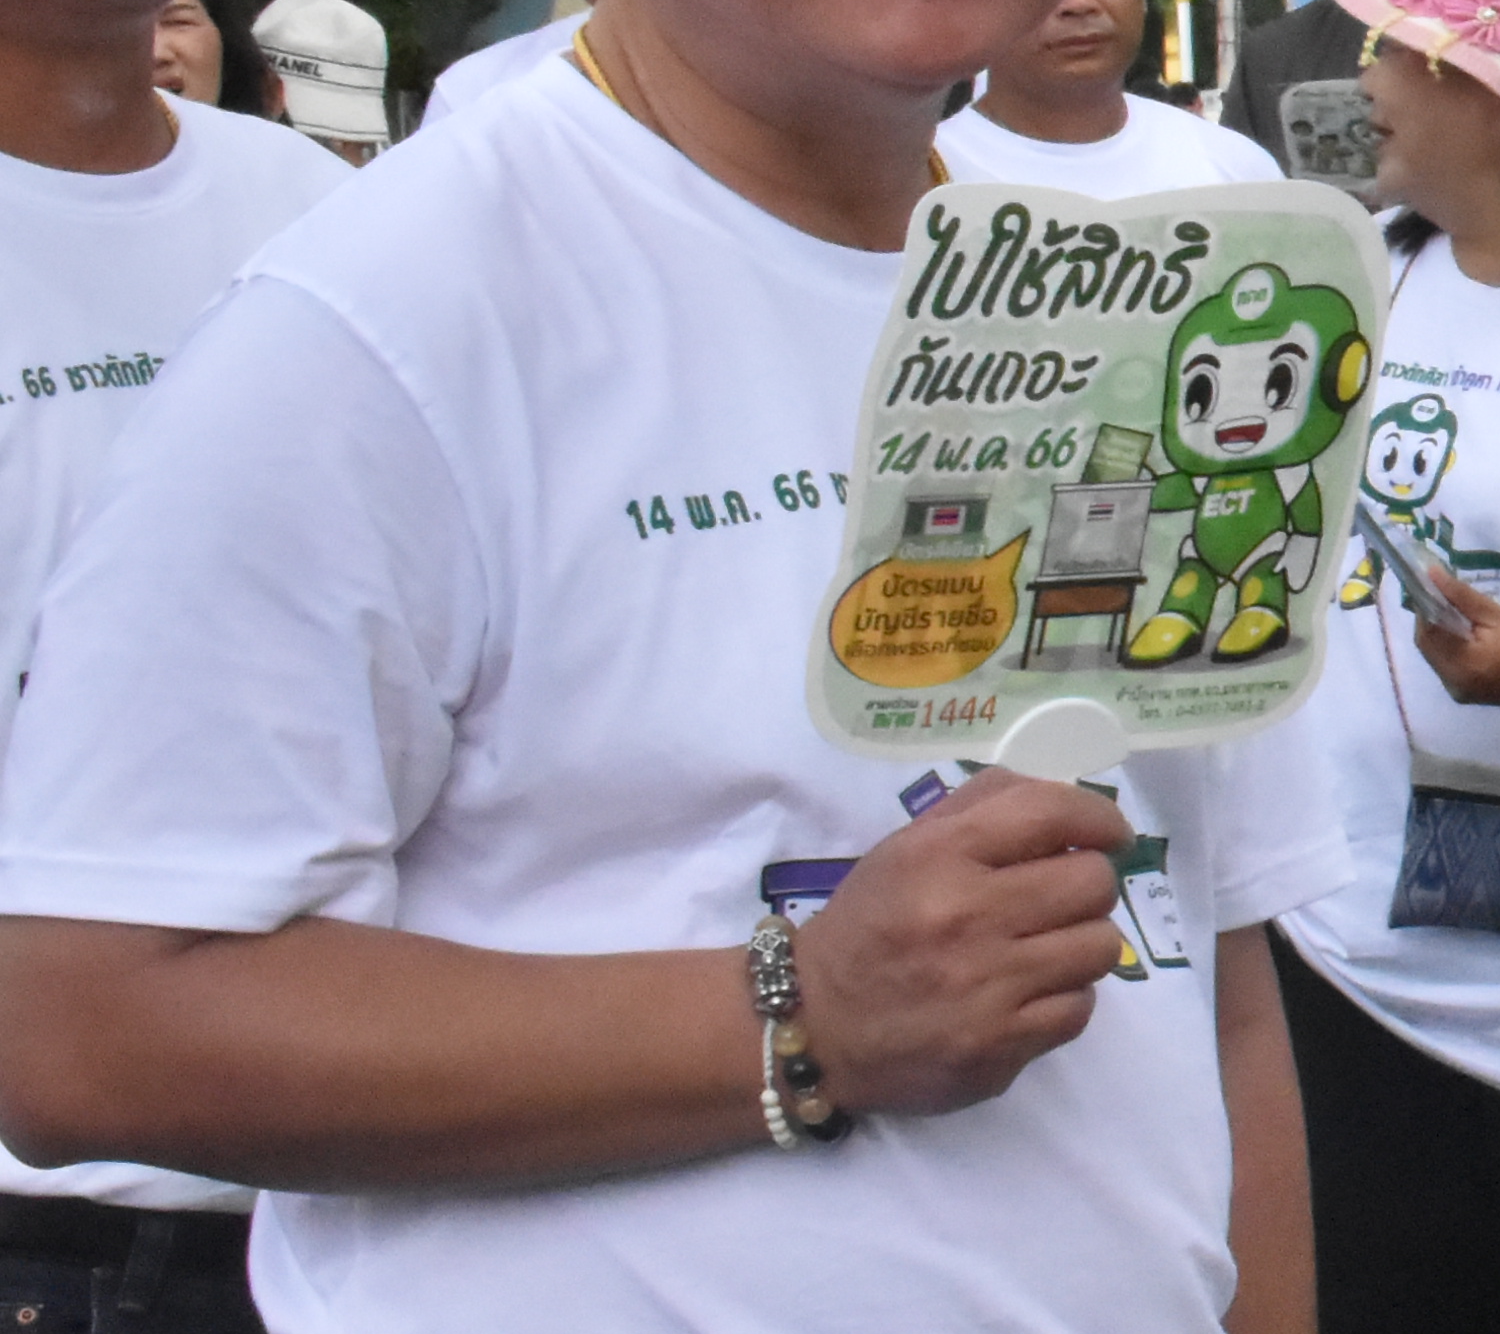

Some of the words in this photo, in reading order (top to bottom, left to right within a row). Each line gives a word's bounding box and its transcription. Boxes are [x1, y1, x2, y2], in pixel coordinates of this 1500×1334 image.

[22, 366, 57, 398] 66
[886, 335, 1099, 406] กันเถอะ
[879, 432, 931, 474] 14
[1025, 427, 1078, 470] 66
[626, 495, 675, 539] 14
[684, 490, 762, 530] พ.ค.
[773, 470, 821, 511] 66
[1203, 488, 1257, 518] ECT
[882, 574, 985, 597] บัตรแบบ
[854, 596, 998, 635] บัญชีรายชื่อ
[921, 695, 996, 728] 1444
